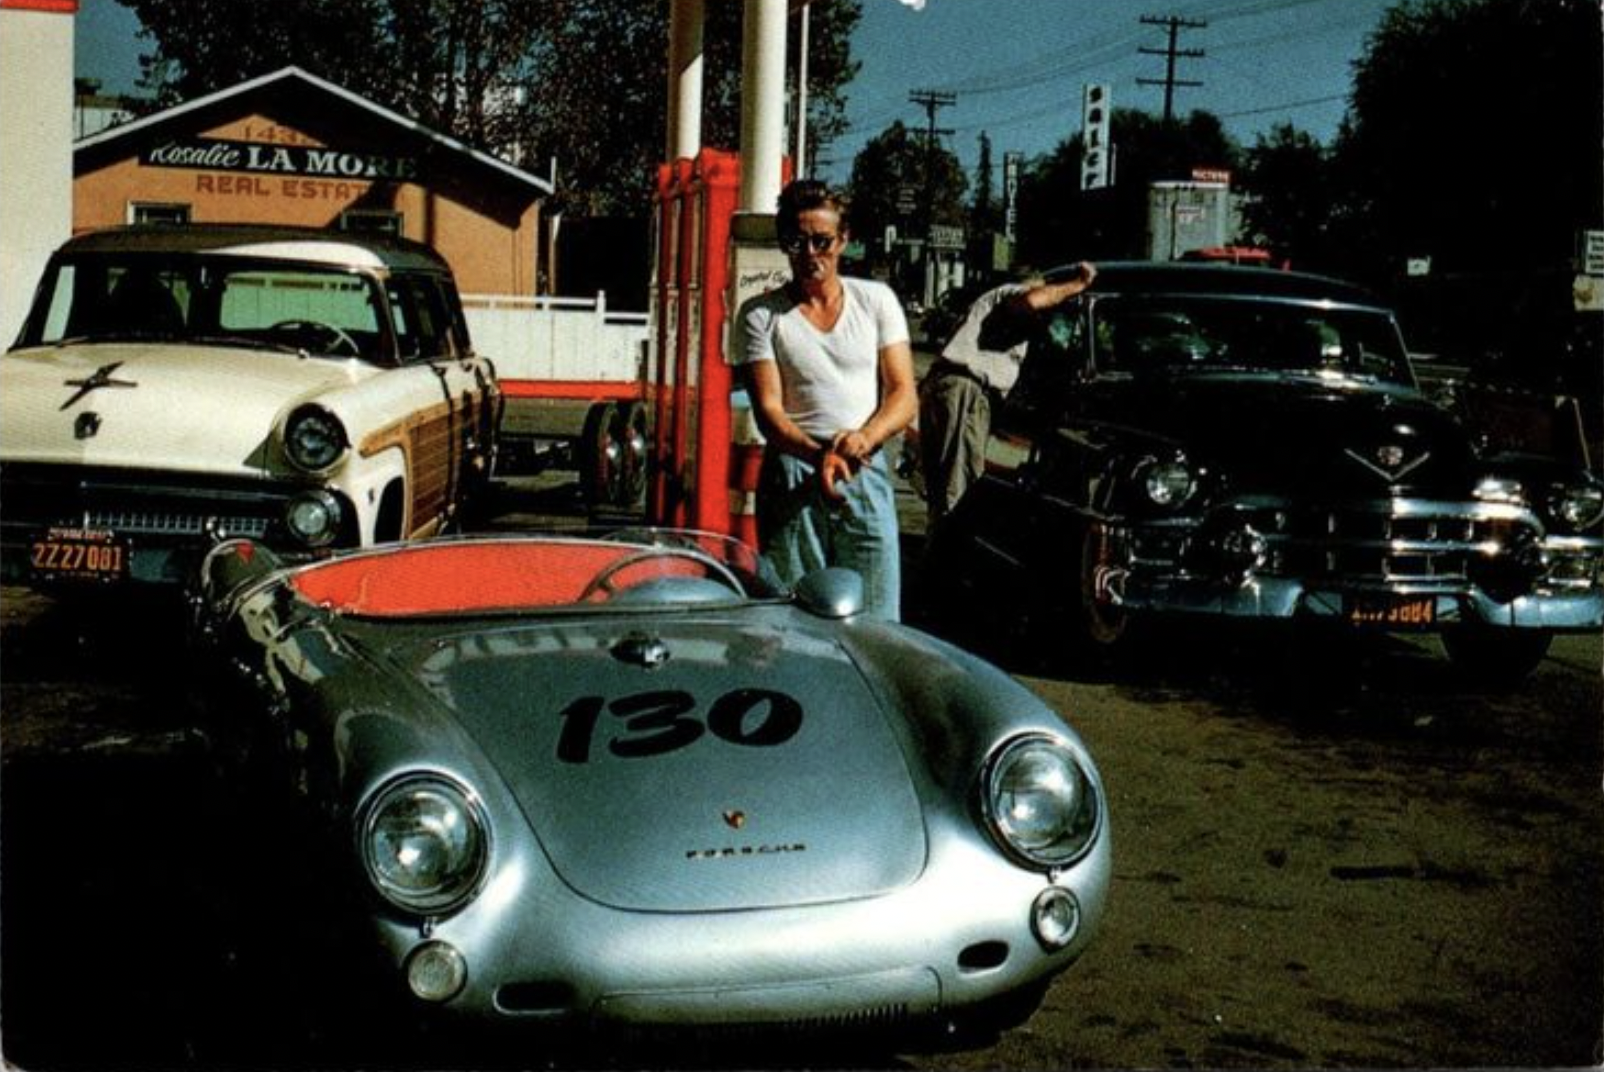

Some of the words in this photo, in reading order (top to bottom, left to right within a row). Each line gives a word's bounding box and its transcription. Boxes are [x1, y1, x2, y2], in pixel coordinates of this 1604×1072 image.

[245, 125, 308, 145] 143
[246, 146, 298, 171] LA
[306, 150, 417, 178] MORE
[197, 175, 271, 198] REAL
[283, 179, 374, 202] ESTAT
[556, 688, 804, 764] 130
